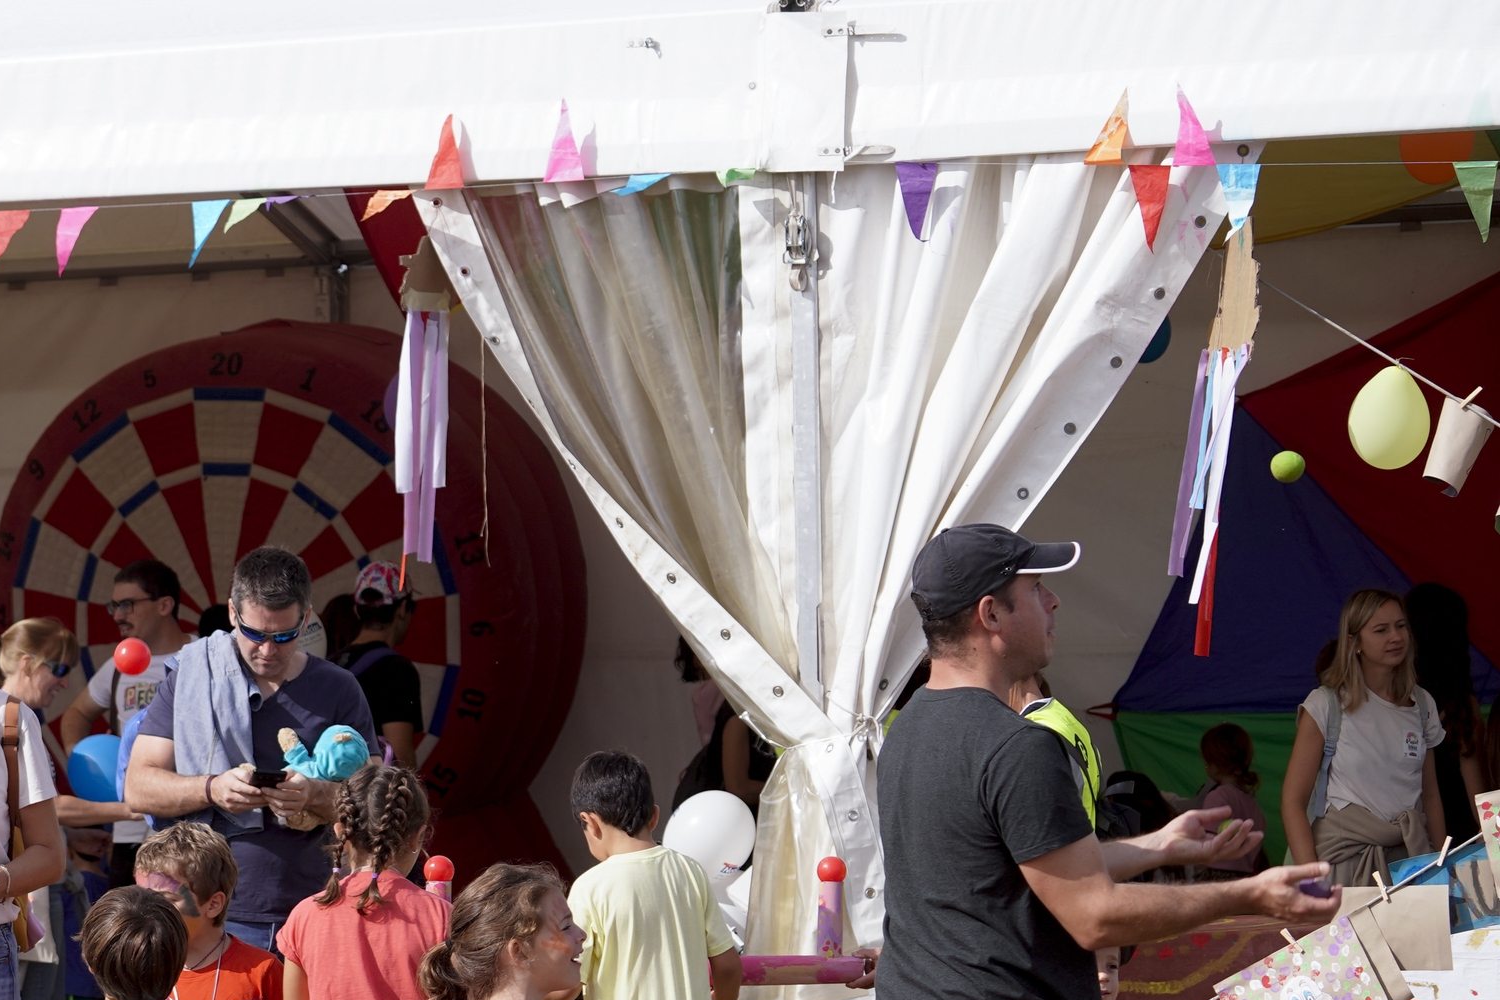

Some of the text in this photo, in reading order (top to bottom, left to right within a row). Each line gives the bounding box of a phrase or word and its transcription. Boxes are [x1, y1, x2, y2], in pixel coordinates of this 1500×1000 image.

[209, 352, 244, 376] 20
[143, 368, 157, 388] 5
[300, 367, 317, 392] 1
[72, 398, 102, 433] 12
[28, 459, 46, 480] 9
[454, 531, 484, 566] 13
[469, 621, 494, 637] 6
[457, 688, 487, 722] 10
[425, 763, 459, 798] 15
